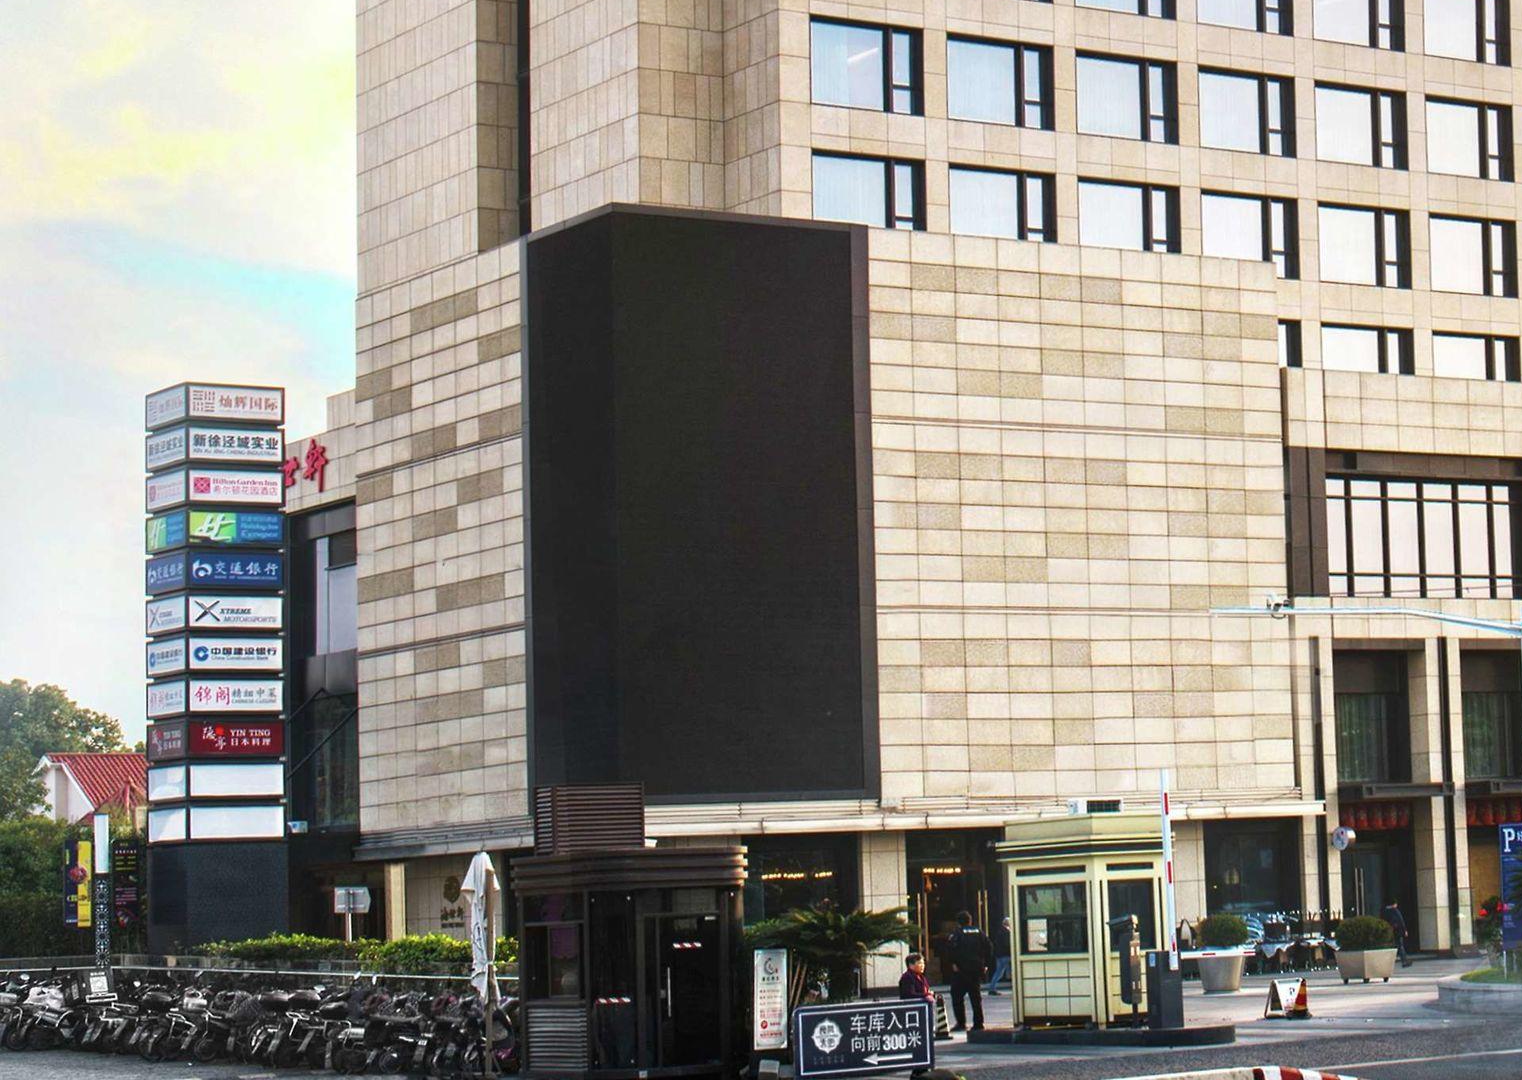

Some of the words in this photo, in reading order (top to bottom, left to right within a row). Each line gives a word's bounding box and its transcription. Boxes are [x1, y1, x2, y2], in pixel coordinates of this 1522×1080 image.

[193, 433, 279, 450] 新徐泾城实业
[211, 647, 277, 656] 中国建设银行
[230, 729, 246, 737] YIN
[231, 738, 271, 746] 日本料理
[1502, 827, 1516, 852] P
[850, 1010, 920, 1034] 车库入口
[850, 1031, 922, 1053] 向前300米
